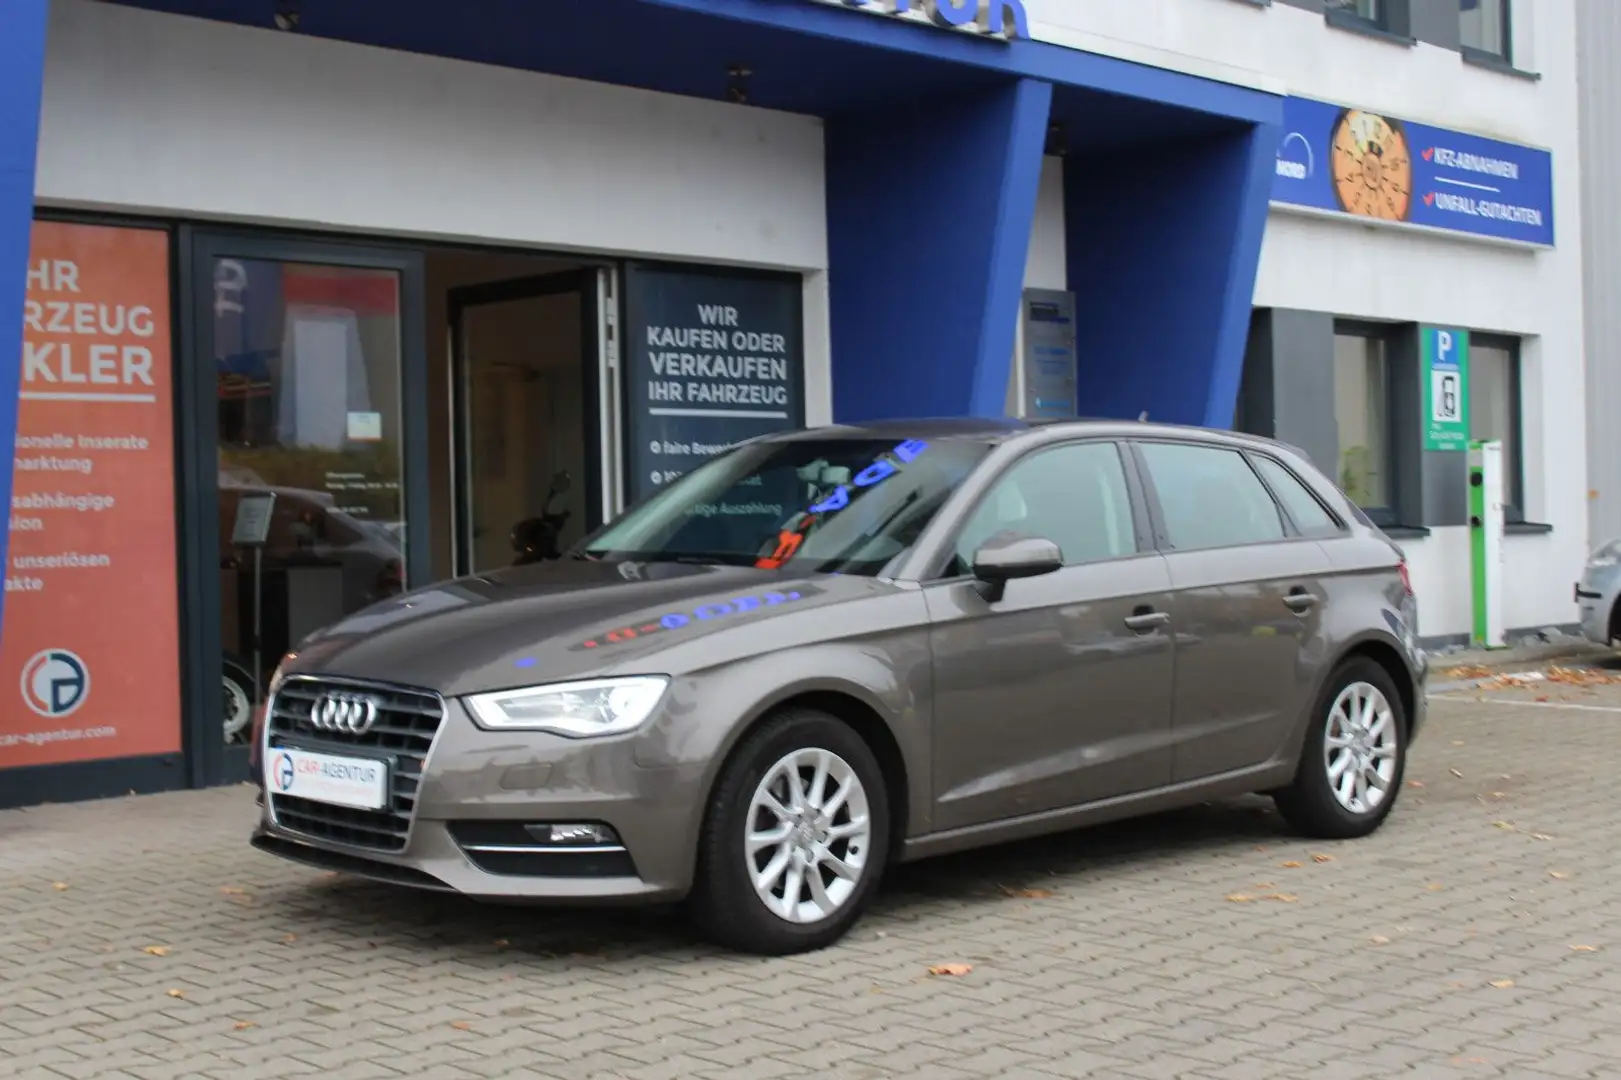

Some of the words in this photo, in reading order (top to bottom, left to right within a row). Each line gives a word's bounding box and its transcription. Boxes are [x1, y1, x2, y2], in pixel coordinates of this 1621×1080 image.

[1433, 146, 1518, 180] KFZ-ABNAHMEN
[1434, 192, 1543, 226] UNFALL-GUTACHTEN
[697, 304, 739, 327] WIR
[646, 325, 728, 350] KAUFEN
[731, 331, 786, 353] ODER
[1437, 330, 1452, 361] P
[648, 351, 787, 380] VERKAUFEN
[648, 381, 683, 401] IHR
[687, 382, 788, 405] FAHRZEUG
[295, 758, 376, 784] CAR-AGENTUR
